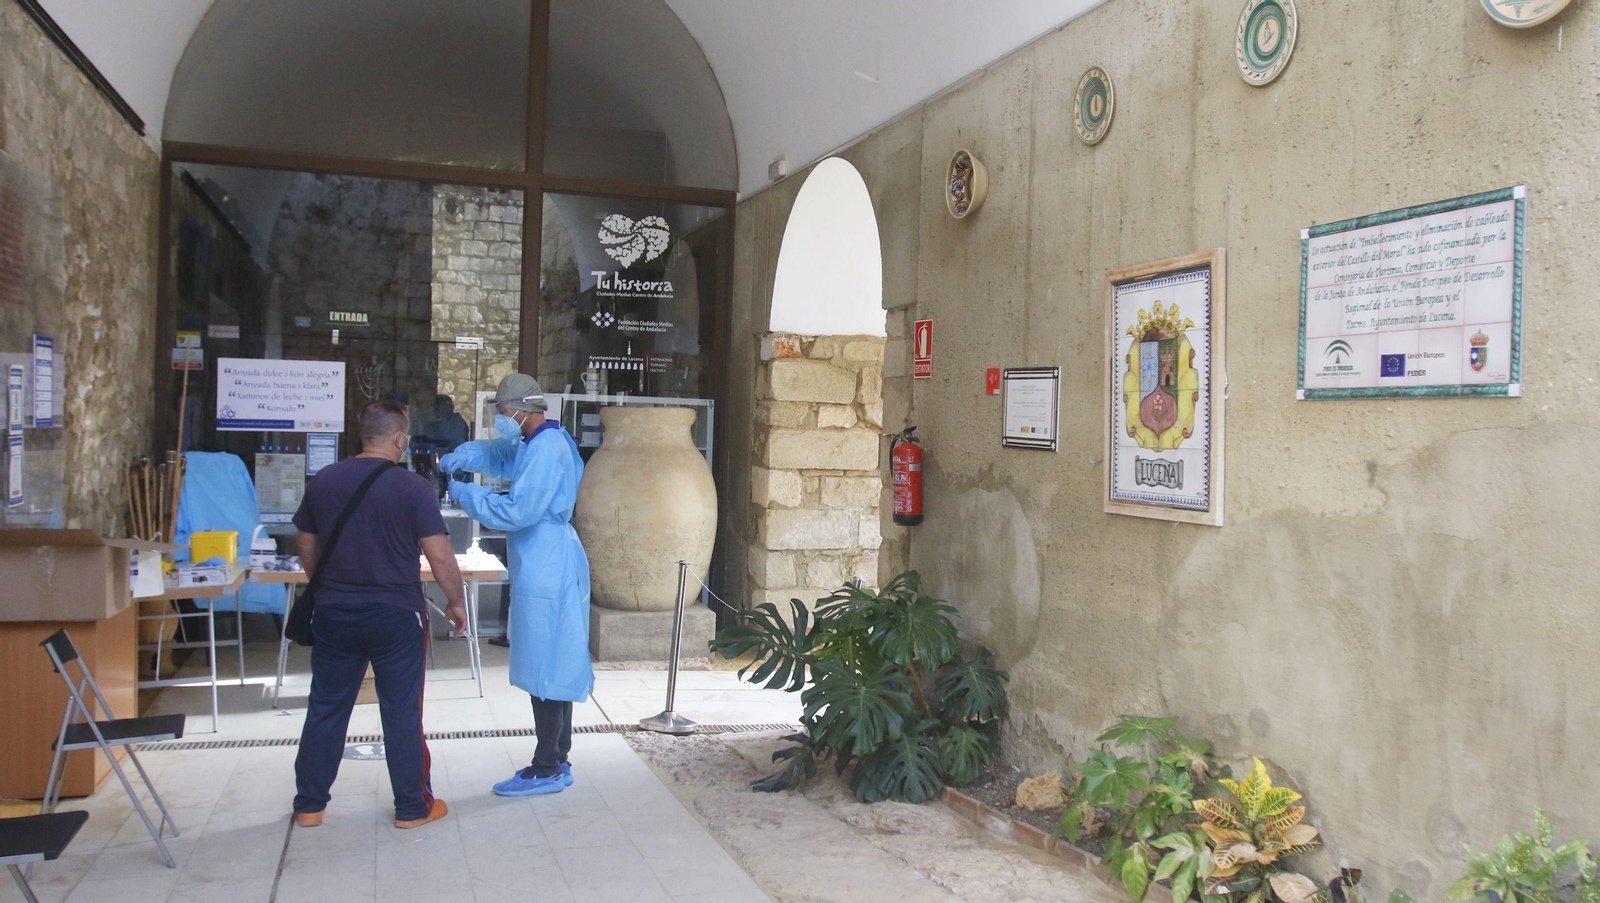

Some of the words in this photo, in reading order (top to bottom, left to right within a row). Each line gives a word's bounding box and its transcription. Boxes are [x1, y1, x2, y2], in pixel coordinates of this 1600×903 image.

[1312, 247, 1318, 255] La
[1320, 241, 1348, 253] actuación
[1350, 238, 1356, 248] de
[1415, 230, 1420, 241] y
[1421, 220, 1462, 236] eliminación
[1465, 216, 1473, 228] de
[1476, 210, 1510, 226] cableado
[1313, 260, 1335, 270] exterior
[1337, 255, 1347, 266] del
[1348, 252, 1370, 265] Castillo
[1372, 250, 1382, 260] del
[1407, 244, 1416, 255] ha
[1418, 241, 1431, 254] sido
[1433, 233, 1480, 254] cofinanciada
[1481, 234, 1496, 248] por
[1499, 229, 1506, 240] la
[1366, 268, 1373, 278] de
[1375, 266, 1403, 277] Turismo,
[1406, 259, 1436, 272] Comercio
[1439, 260, 1443, 271] y
[1445, 254, 1475, 269] Deporte
[591, 271, 610, 290] Tu
[614, 271, 674, 292] historia
[1315, 291, 1321, 301] de
[1322, 290, 1328, 300] la
[1329, 289, 1346, 300] Junta
[1348, 286, 1354, 297] de
[1393, 280, 1398, 291] el
[1422, 277, 1451, 289] Europeo
[1453, 272, 1462, 283] de
[1465, 266, 1505, 282] Desarrollo
[1345, 300, 1372, 315] Regional
[1373, 299, 1380, 310] de
[1385, 298, 1390, 308] la
[1393, 296, 1413, 307] Unión
[1416, 295, 1444, 308] Europea
[1446, 294, 1451, 307] y
[1453, 290, 1461, 301] el
[329, 311, 368, 322] ENTRADA
[1370, 315, 1417, 330] Ayuntamiento
[1419, 312, 1427, 322] de
[1429, 312, 1456, 322] Lucena.
[263, 369, 283, 377] dulce
[273, 381, 296, 389] buena
[283, 393, 302, 401] leche
[1140, 463, 1176, 483] LUCENA
